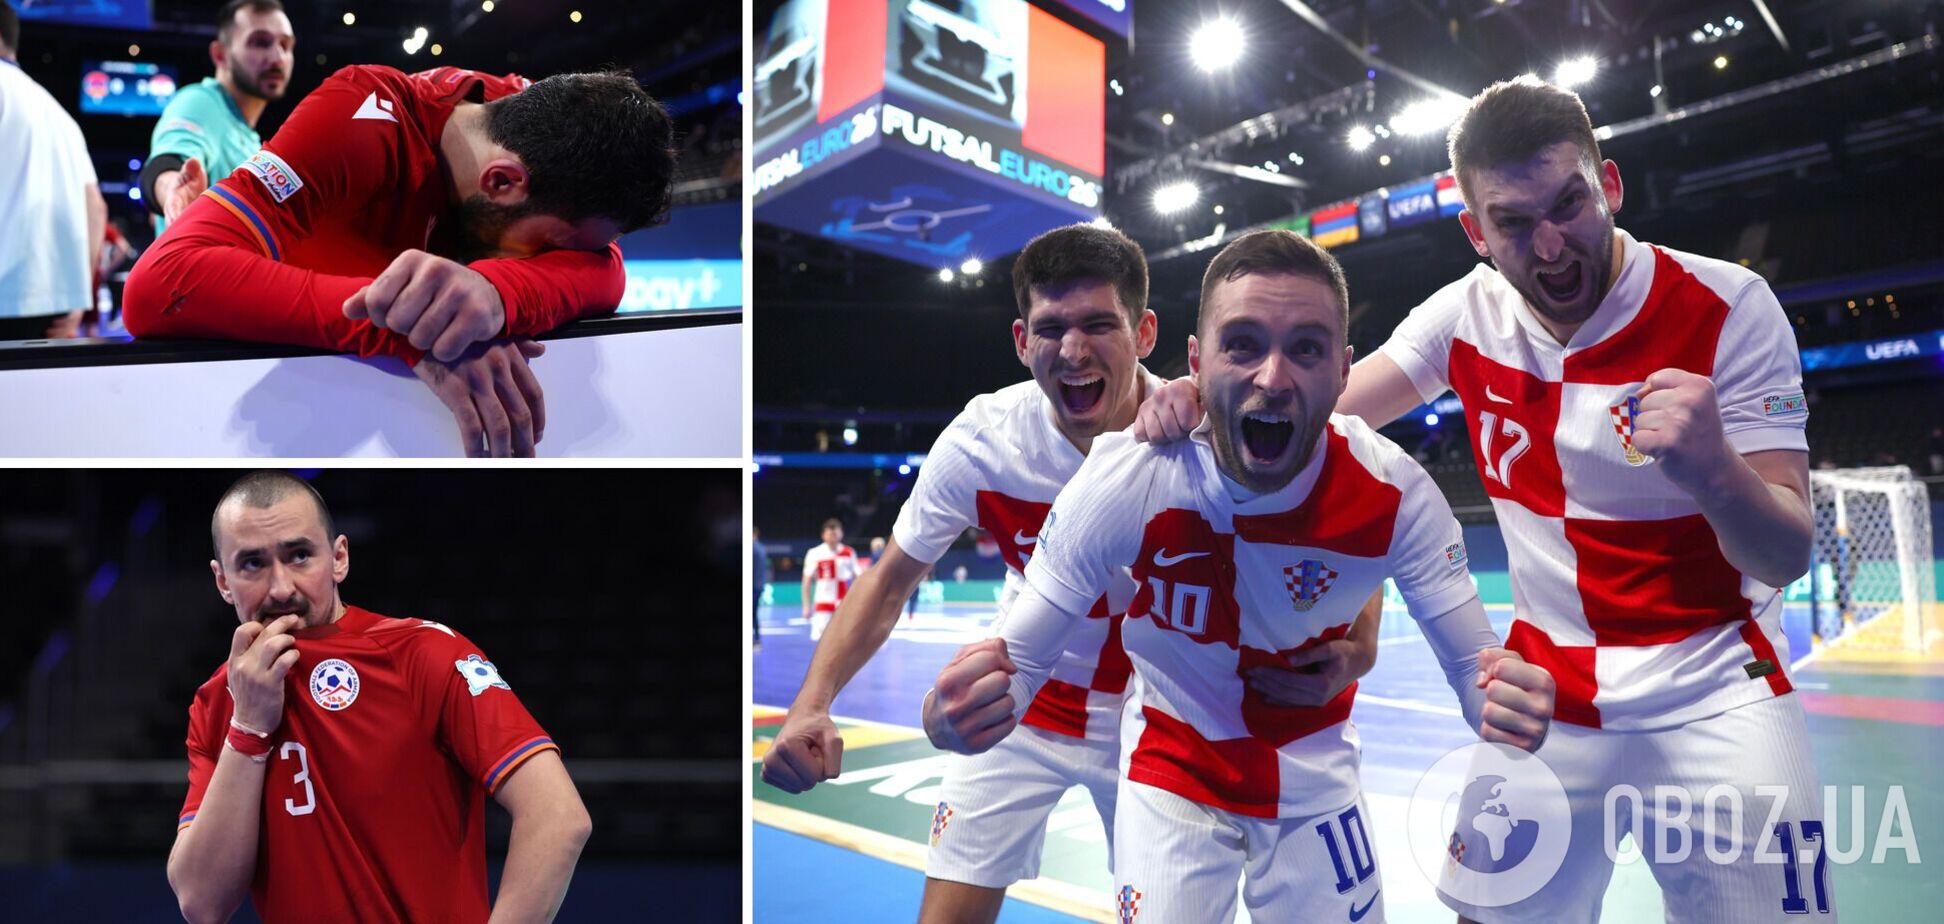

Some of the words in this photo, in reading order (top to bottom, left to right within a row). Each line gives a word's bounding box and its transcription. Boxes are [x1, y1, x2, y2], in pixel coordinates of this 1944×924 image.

[1387, 193, 1435, 220] UEFA
[1865, 338, 1920, 361] UEFA
[1479, 410, 1532, 490] 17
[1147, 575, 1213, 636] 10
[280, 741, 316, 816] 3
[1315, 804, 1376, 895] 10
[1772, 820, 1830, 914] 17
